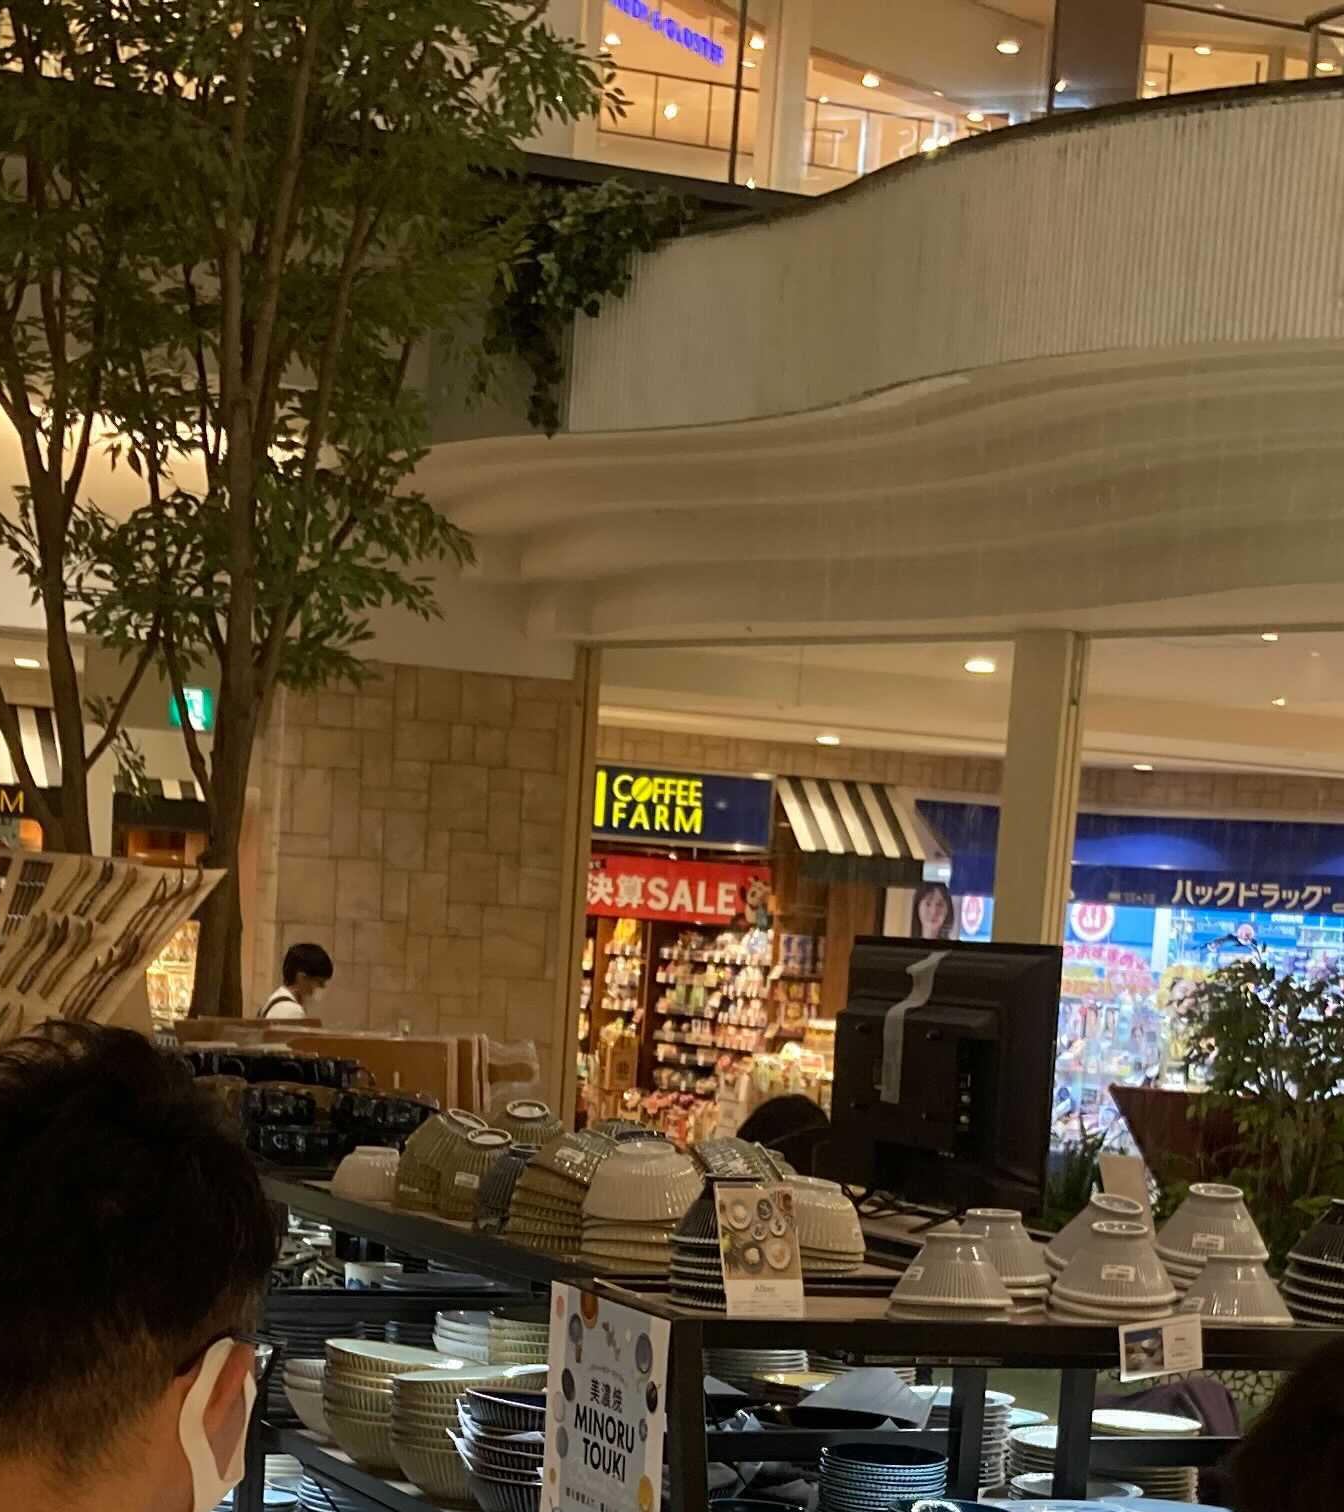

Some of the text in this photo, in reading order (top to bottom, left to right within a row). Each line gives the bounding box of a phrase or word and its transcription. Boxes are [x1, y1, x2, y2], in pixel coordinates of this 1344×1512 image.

[612, 774, 704, 808] COFFEE
[612, 801, 703, 835] FARM
[1171, 878, 1333, 911] ハックドラッグ
[574, 1402, 636, 1455] MINORU
[582, 1437, 627, 1483] TOUKI
